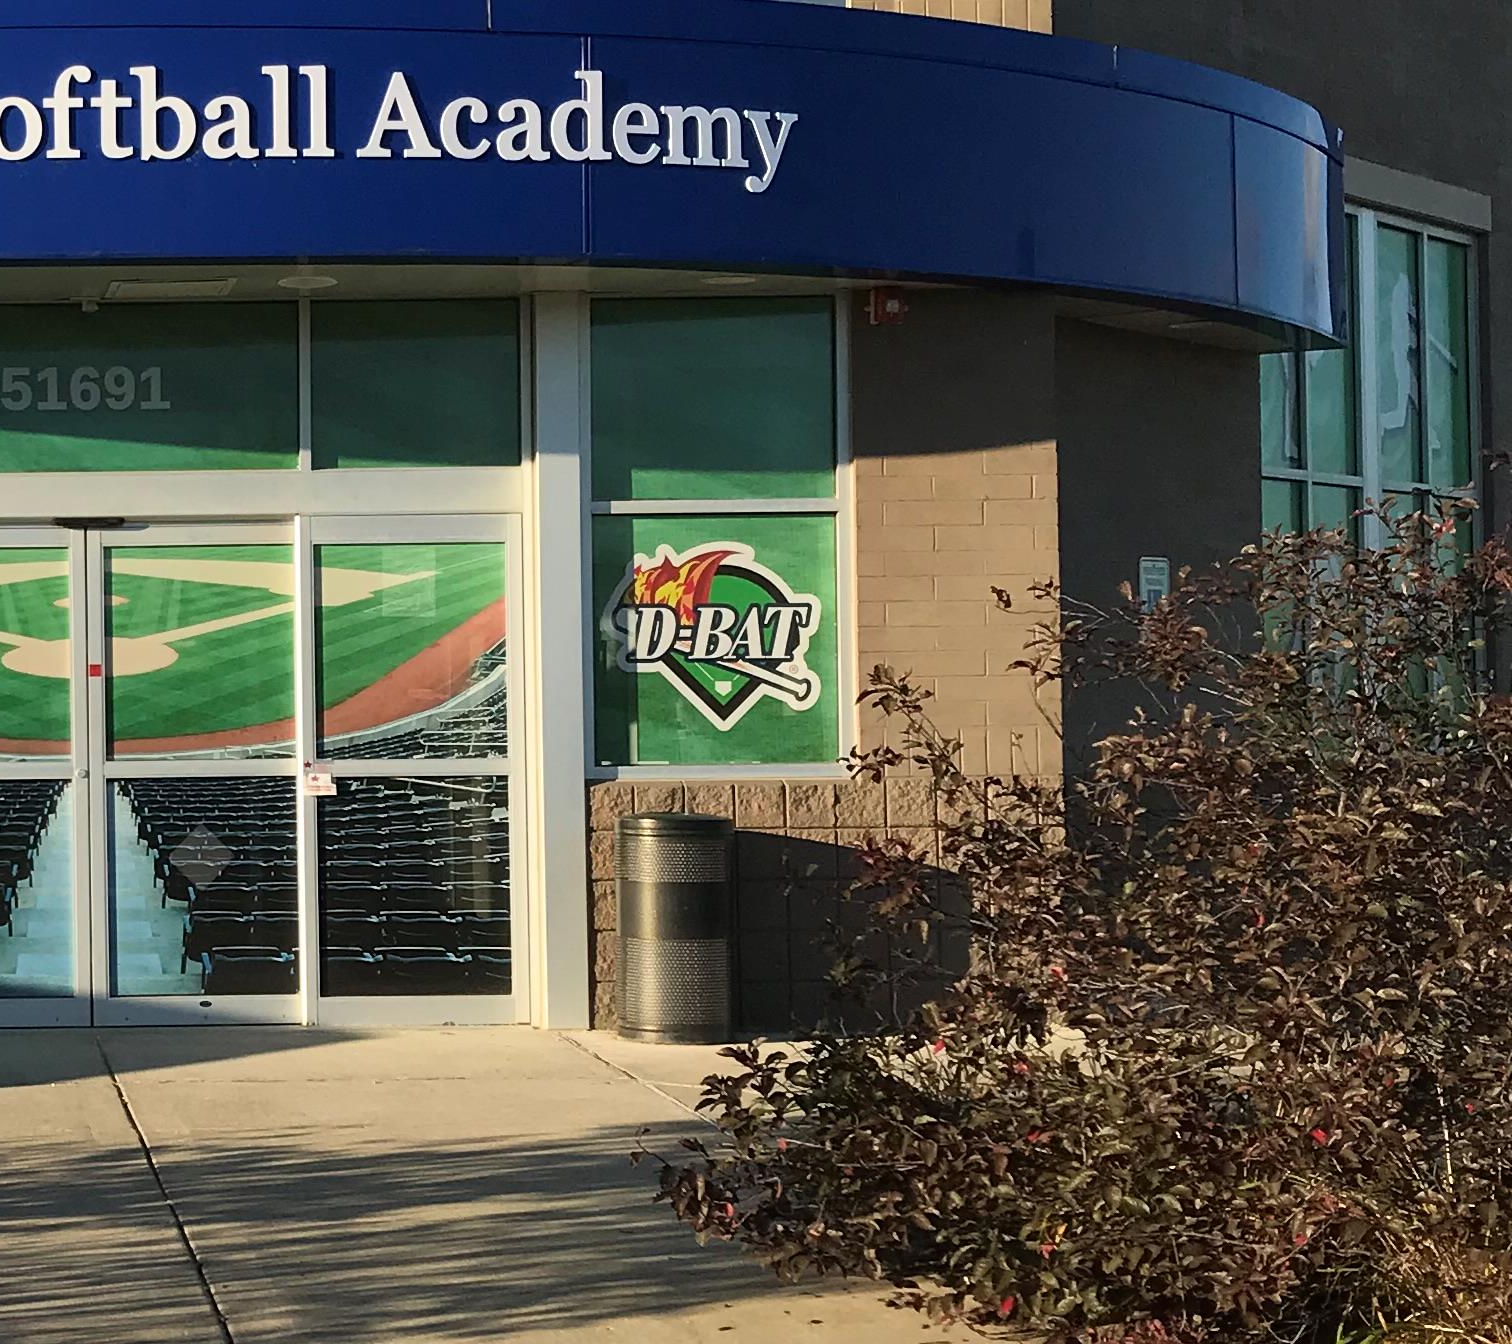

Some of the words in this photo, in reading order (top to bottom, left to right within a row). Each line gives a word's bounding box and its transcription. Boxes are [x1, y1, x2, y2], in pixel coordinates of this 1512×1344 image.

[356, 69, 799, 193] Academy
[1, 366, 172, 411] 51691
[626, 606, 809, 660] D-BAT
